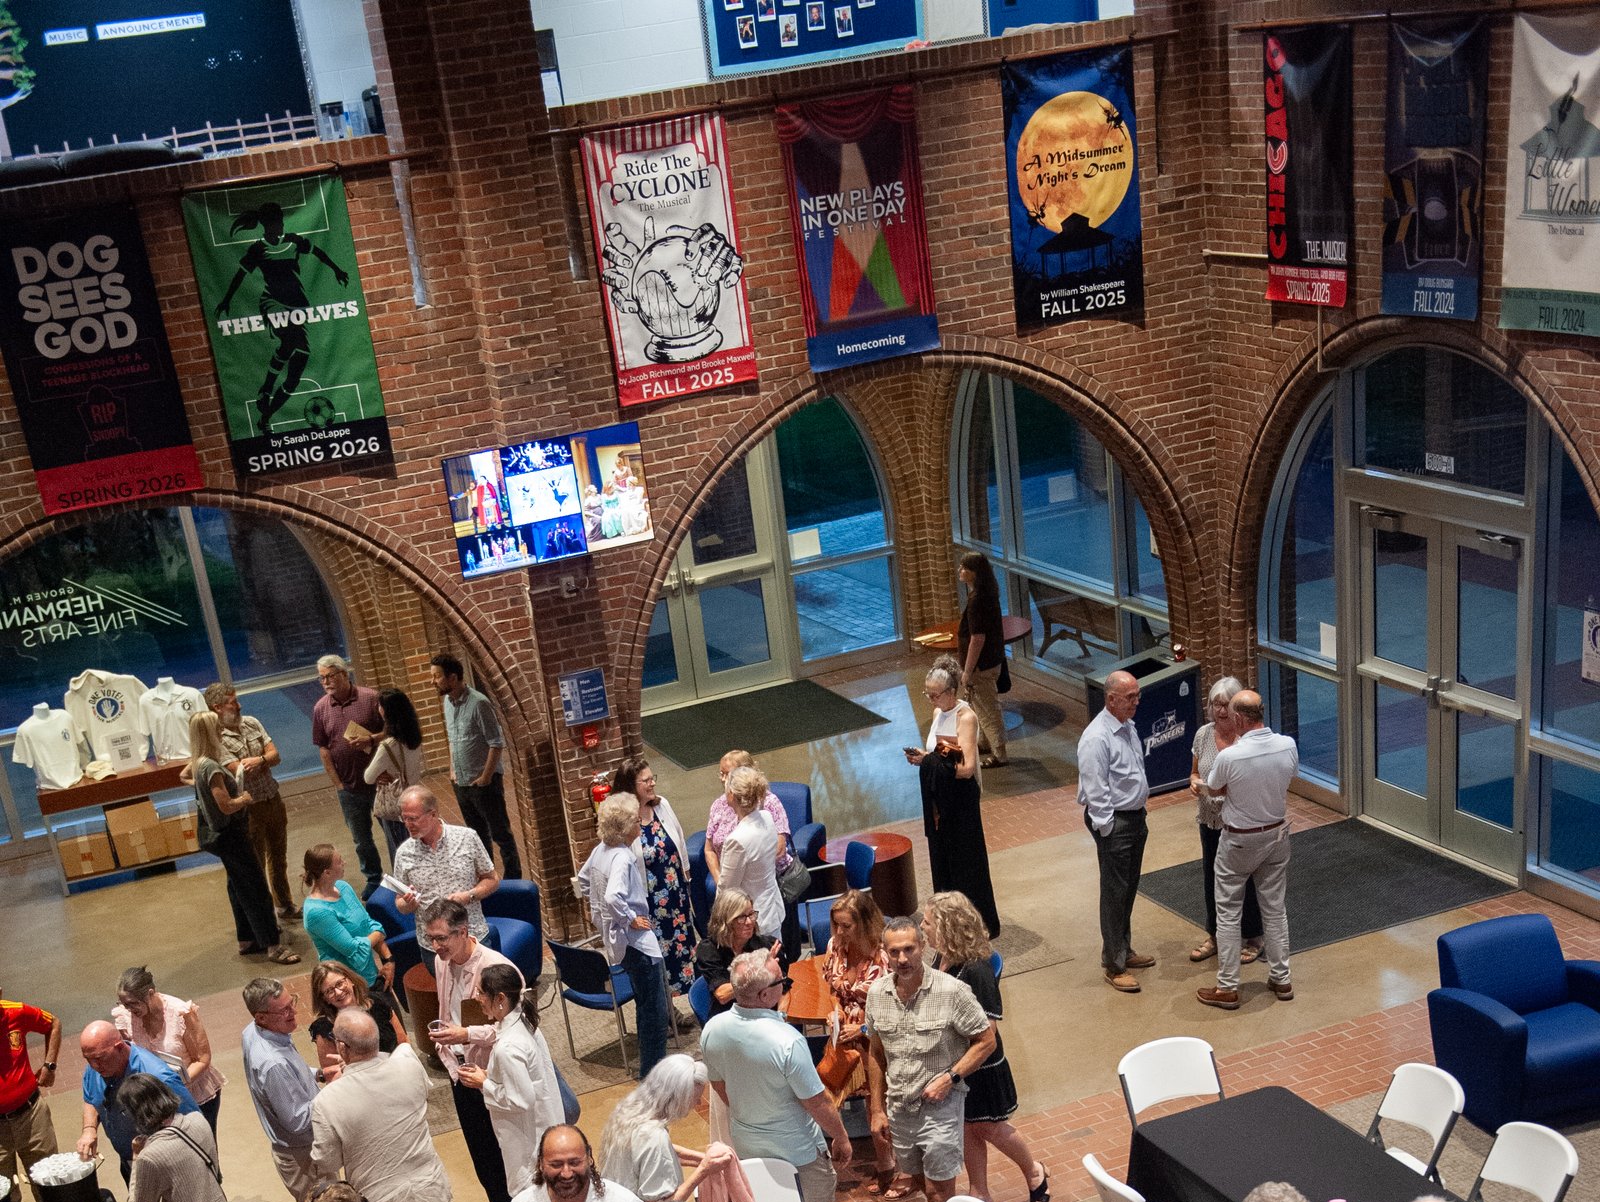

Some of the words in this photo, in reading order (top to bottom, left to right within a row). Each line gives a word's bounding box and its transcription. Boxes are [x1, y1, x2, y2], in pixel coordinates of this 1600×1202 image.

[48, 31, 86, 42] MUSIC
[102, 16, 204, 37] ANNOUNCEMENTS
[623, 159, 658, 177] Ride
[661, 154, 692, 171] The
[1023, 154, 1042, 172] A
[1046, 144, 1124, 167] Midsummer
[1527, 142, 1573, 180] Little
[610, 168, 712, 205] CYCLONE
[1027, 170, 1078, 190] Night's
[1083, 161, 1126, 179] Dream
[637, 202, 655, 212] The
[657, 195, 691, 210] Musical
[800, 192, 844, 214] NEW
[850, 181, 905, 205] PLAYS
[802, 213, 822, 231] IN
[827, 205, 868, 227] ONE
[873, 198, 906, 219] DAY
[804, 214, 907, 241] FESTIVAL
[11, 234, 119, 285] DOG
[1306, 241, 1321, 259] THE
[18, 272, 131, 323] SEES
[1040, 292, 1050, 301] by
[1050, 288, 1078, 299] William
[1079, 280, 1125, 294] Shakespeare
[1041, 298, 1080, 318] FALL
[1085, 290, 1126, 310] 2025
[1286, 280, 1311, 301] SPRING
[1312, 282, 1330, 303] 2025
[1413, 291, 1432, 312] FALL
[1433, 292, 1455, 314] 2024
[217, 315, 265, 337] THE
[267, 300, 359, 329] WOLVES
[1538, 306, 1558, 330] FALL
[1561, 309, 1585, 332] 2024
[34, 311, 138, 359] GOD
[837, 334, 906, 355] Homecoming
[619, 378, 627, 386] by
[628, 373, 649, 384] Jacob
[649, 366, 686, 380] Richmond
[687, 363, 700, 374] and
[701, 358, 726, 369] Brooke
[727, 352, 755, 364] Maxwell
[642, 379, 686, 399] FALL
[690, 367, 735, 390] 2025
[90, 402, 116, 424] RIP
[271, 438, 282, 447] by
[283, 433, 309, 446] Sarah
[310, 427, 350, 441] DeLappe
[248, 445, 325, 472] SPRING
[331, 436, 380, 459] 2026
[58, 482, 133, 509] SPRING
[137, 473, 187, 495] 2026
[89, 691, 101, 705] ONE
[101, 689, 123, 700] VOTE!
[1144, 724, 1186, 756] PIONEERS
